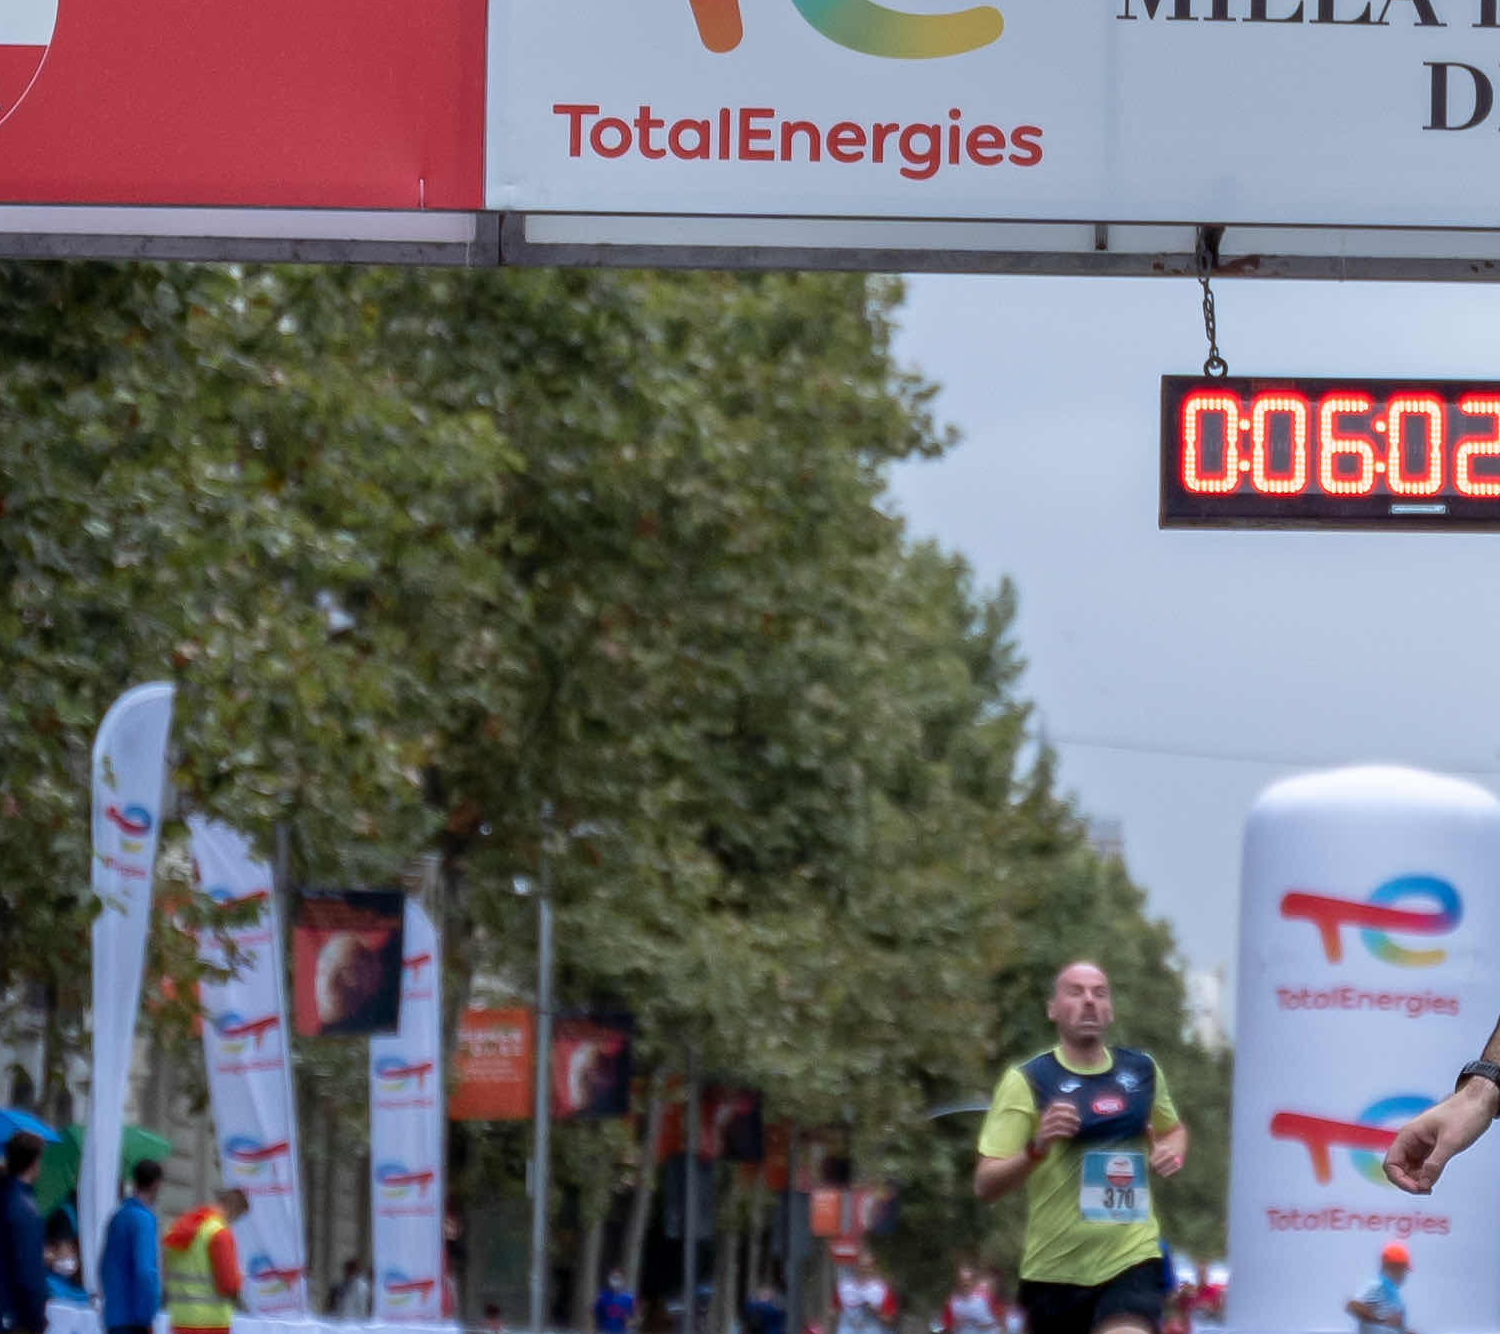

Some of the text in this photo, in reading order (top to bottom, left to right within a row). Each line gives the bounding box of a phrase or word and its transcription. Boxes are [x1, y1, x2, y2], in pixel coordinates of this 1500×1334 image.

[551, 103, 1044, 181] TotalEnergies
[1274, 985, 1461, 1020] TotalEnergies
[1102, 1186, 1135, 1210] 370
